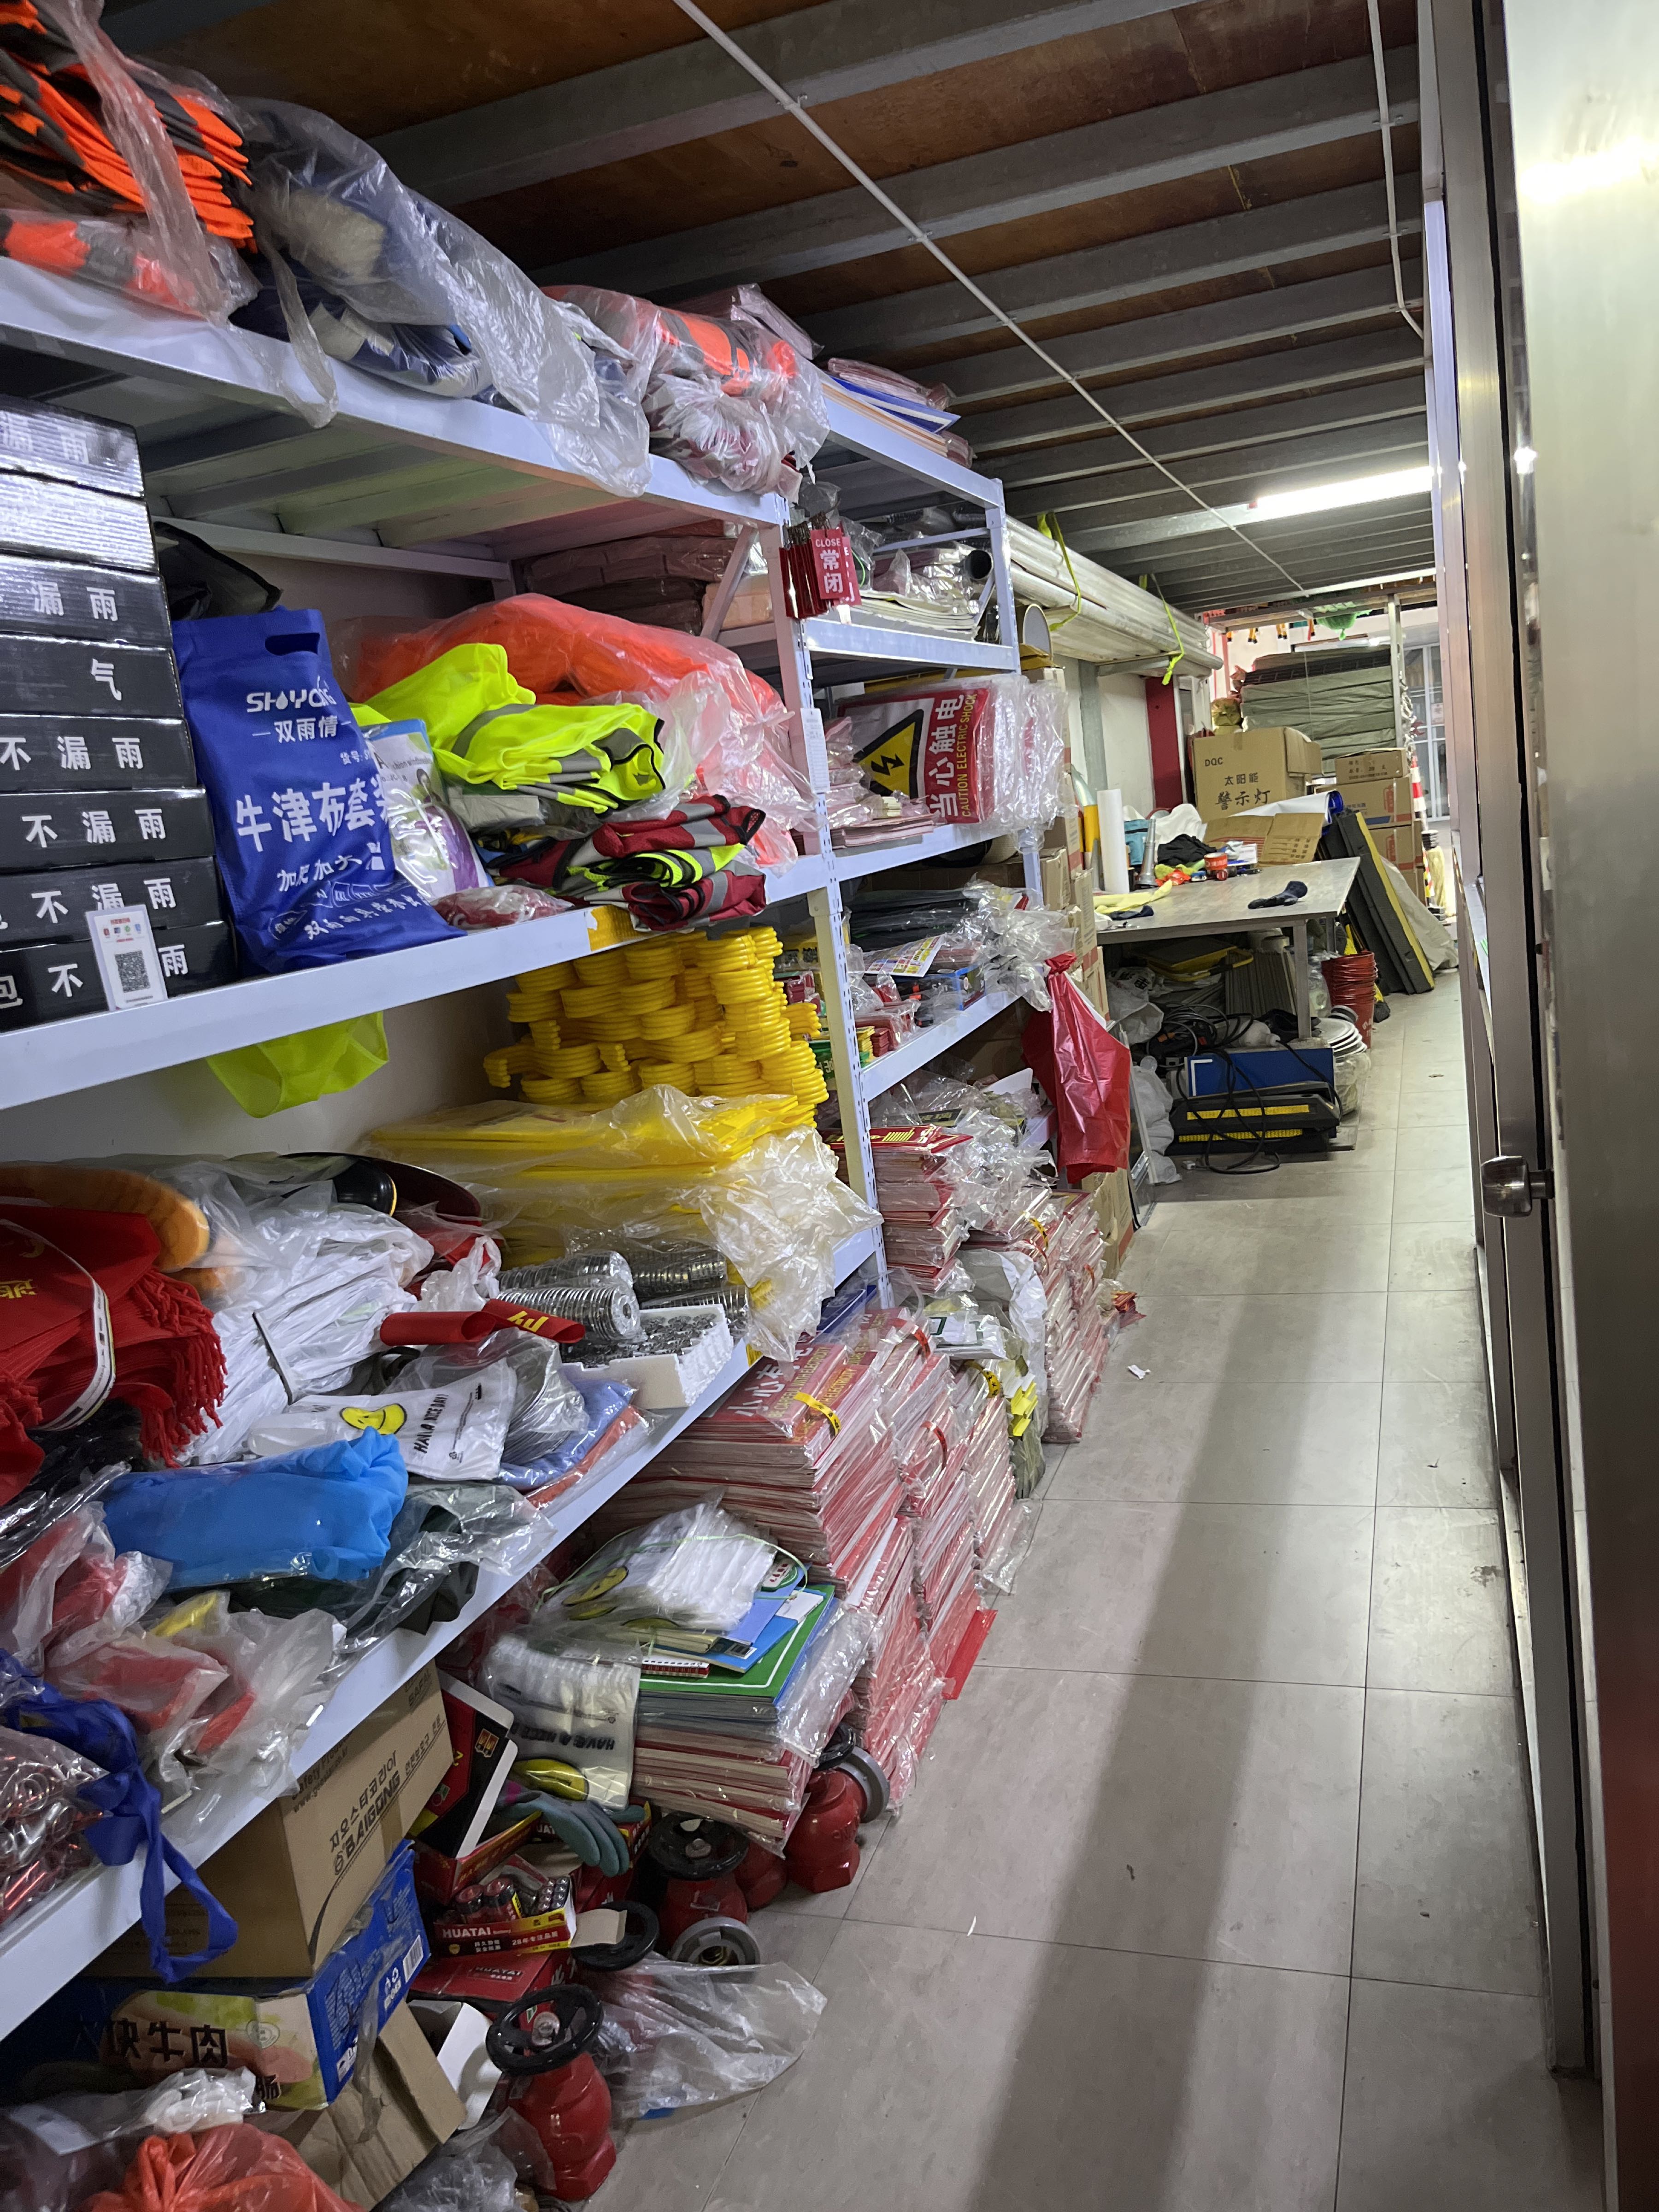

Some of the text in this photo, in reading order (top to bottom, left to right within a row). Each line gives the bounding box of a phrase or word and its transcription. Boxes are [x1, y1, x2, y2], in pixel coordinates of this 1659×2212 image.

[815, 538, 841, 547] CLOSE
[820, 549, 844, 594] 常闭
[91, 658, 123, 701] 气
[274, 715, 338, 743] 双雨情
[928, 694, 965, 818] 当心触电
[956, 693, 977, 817] CAUTION ELECTRIC SHOCK
[1224, 772, 1259, 786] 太阳能
[1215, 788, 1271, 810] 警示灯
[345, 1770, 400, 1860] BAIGONG
[442, 1927, 491, 1938] HUATAI
